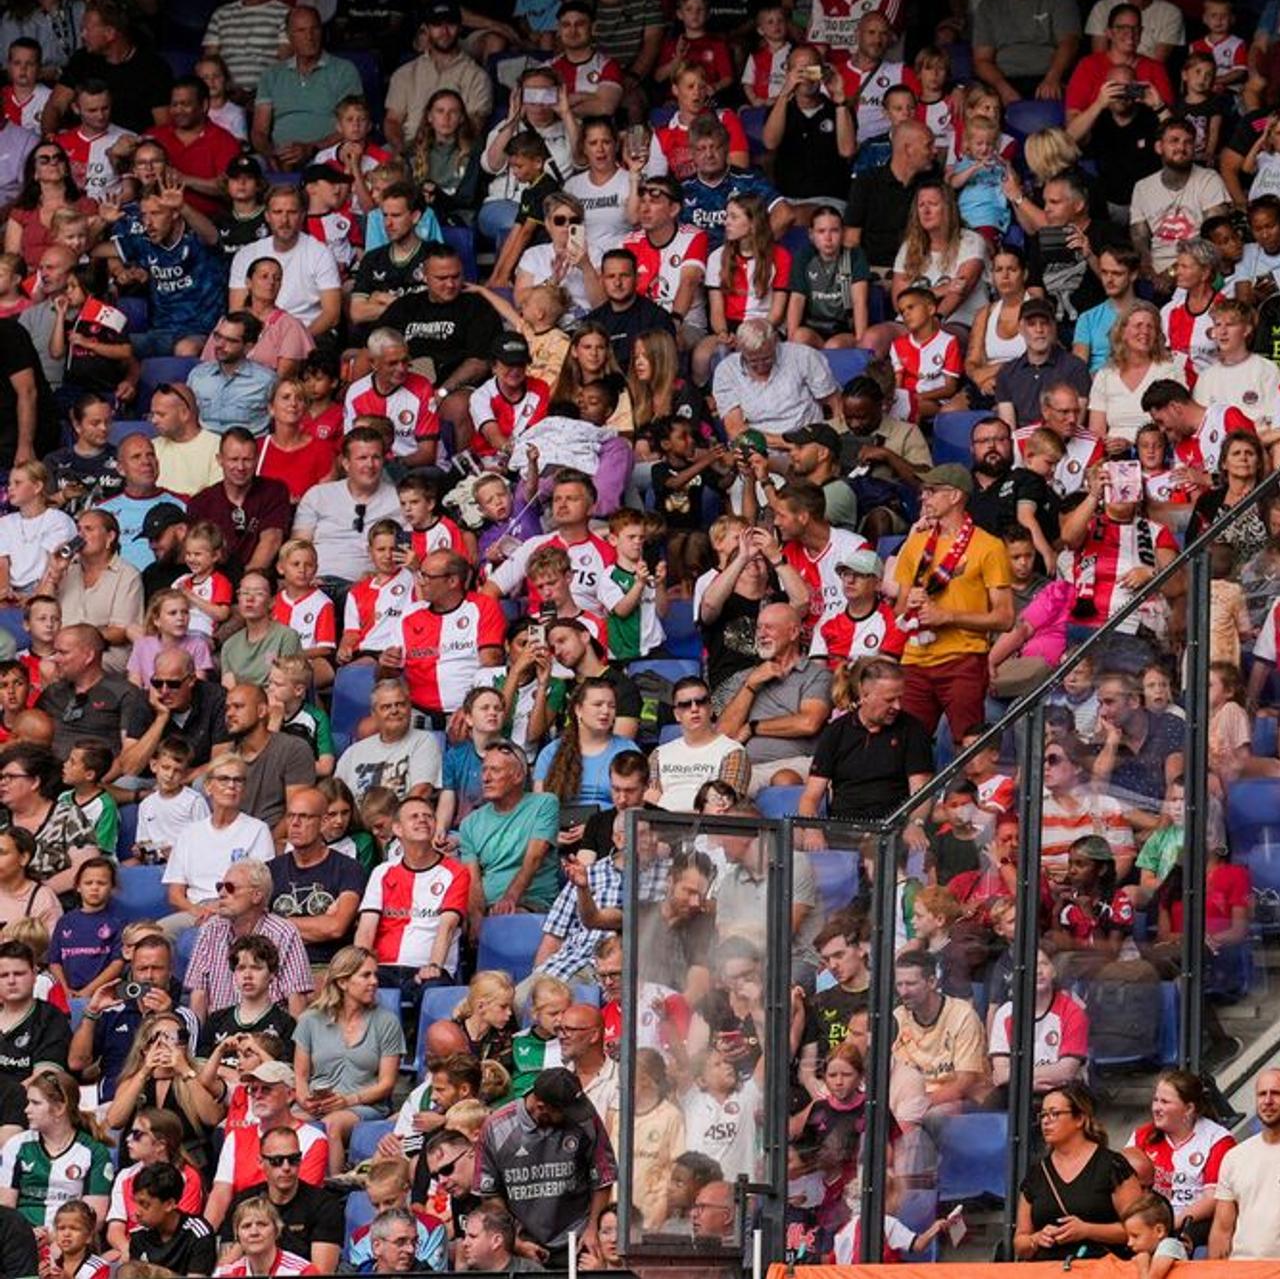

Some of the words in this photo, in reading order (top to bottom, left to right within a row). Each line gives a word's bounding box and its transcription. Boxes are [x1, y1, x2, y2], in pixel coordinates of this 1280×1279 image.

[504, 1167, 530, 1184] STAD
[532, 1161, 574, 1181] ROTTERD
[506, 1180, 576, 1201] VERZEKERIN
